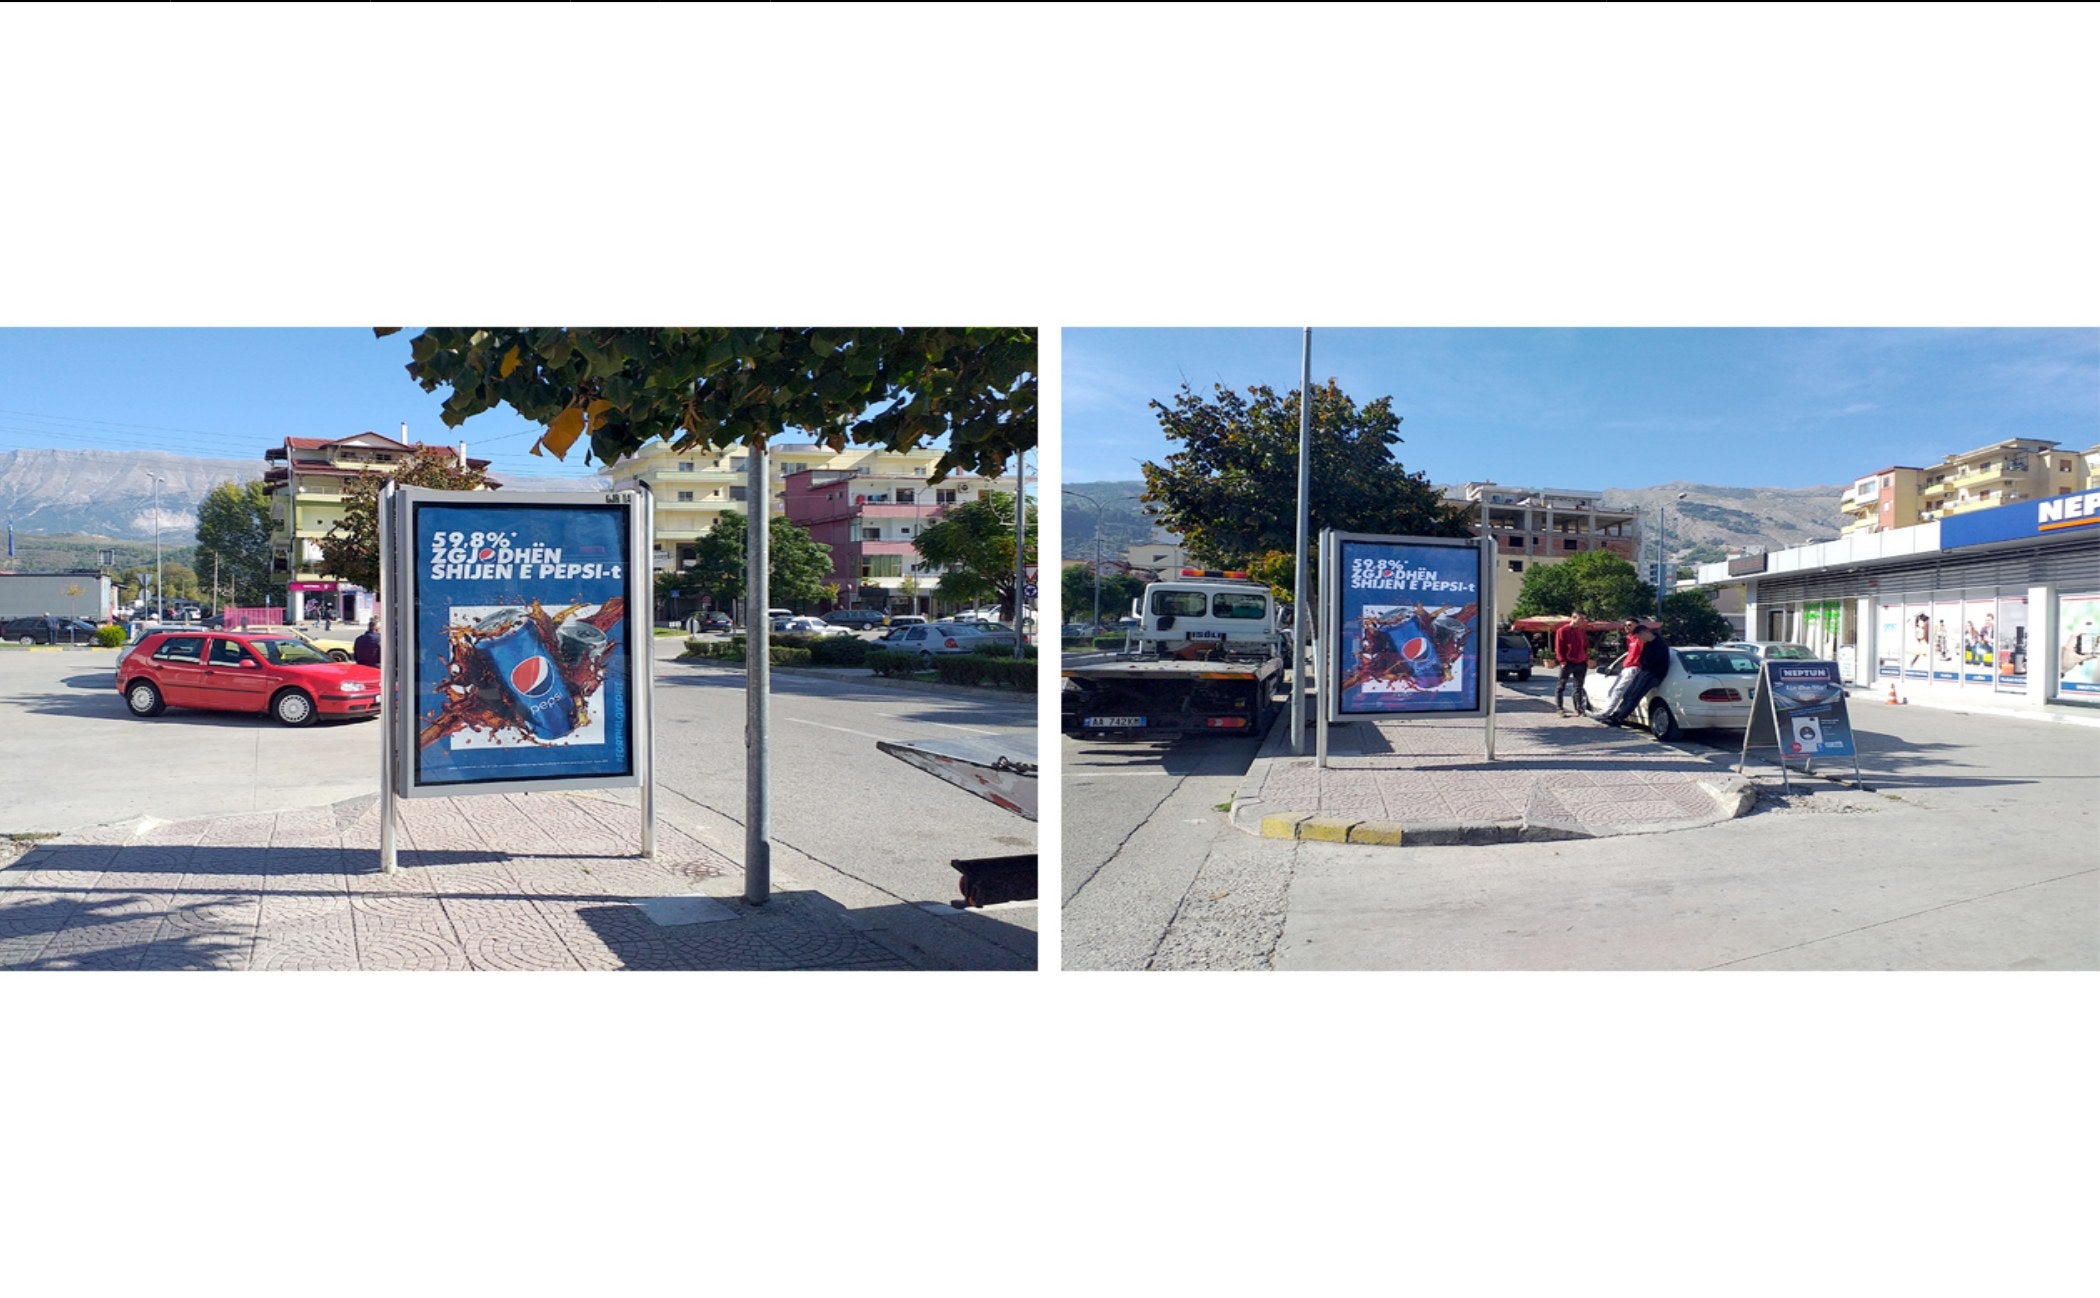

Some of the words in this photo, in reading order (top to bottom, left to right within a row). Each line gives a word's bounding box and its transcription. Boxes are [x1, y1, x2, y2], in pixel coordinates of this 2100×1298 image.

[430, 563, 513, 580] SHIJEN
[519, 563, 532, 580] E
[539, 563, 622, 580] PEPSI-t
[1351, 579, 1406, 590] SHIJEN
[1409, 580, 1419, 590] E
[1422, 581, 1476, 592] PEPSI-t
[1783, 669, 1826, 677] NEPTUN
[530, 692, 563, 715] pepsi
